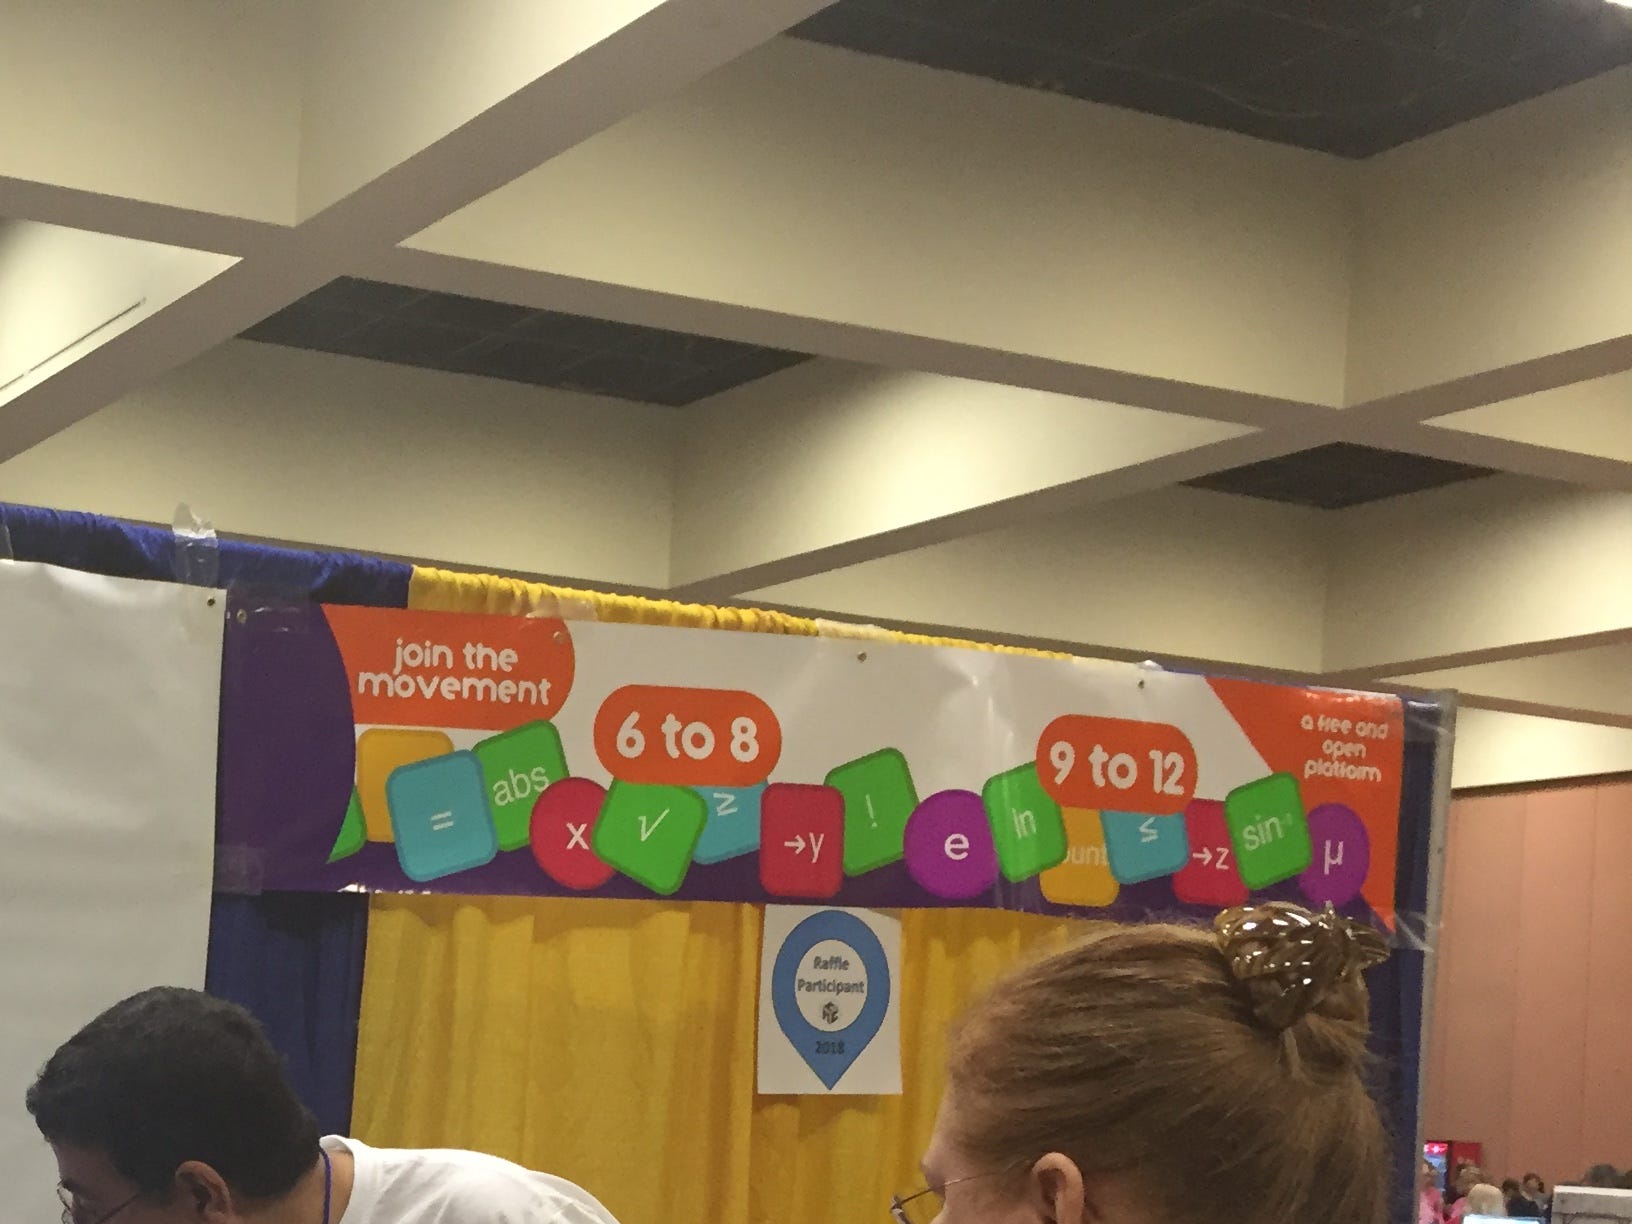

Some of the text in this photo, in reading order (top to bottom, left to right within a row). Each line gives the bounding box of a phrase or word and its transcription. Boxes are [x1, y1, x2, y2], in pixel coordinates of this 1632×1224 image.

[393, 637, 518, 675] join the
[358, 672, 552, 705] movement
[616, 711, 759, 762] 6 to 8
[1301, 714, 1388, 739] a free and
[1322, 739, 1366, 760] open
[1049, 741, 1185, 795] 9 to 12
[1304, 758, 1382, 782] platform
[492, 766, 550, 806] abs
[944, 833, 970, 860] e
[1063, 846, 1108, 867] unt
[813, 955, 850, 971] Raffle
[797, 978, 865, 996] Participant
[815, 1040, 845, 1055] 2018
